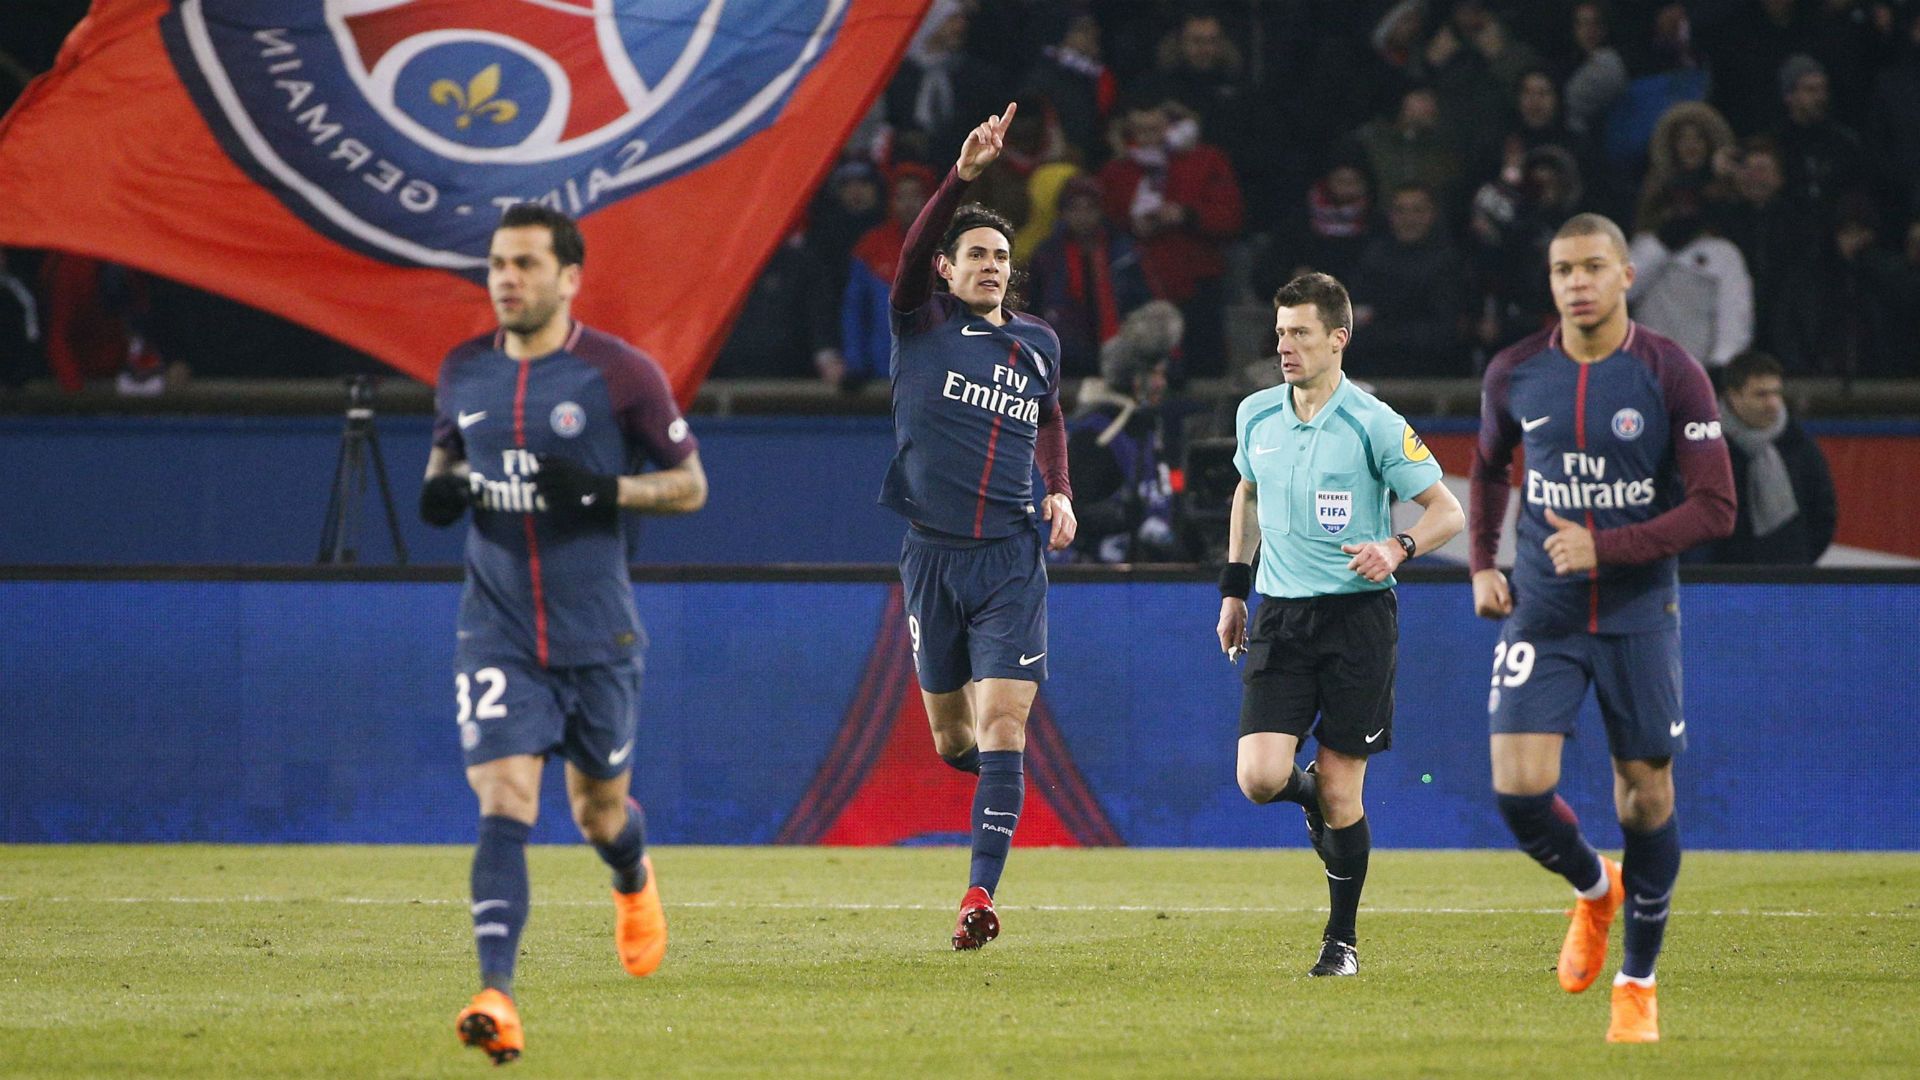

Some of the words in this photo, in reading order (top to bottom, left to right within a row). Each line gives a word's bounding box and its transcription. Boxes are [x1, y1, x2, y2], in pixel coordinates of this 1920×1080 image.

[993, 364, 1028, 393] Fly
[942, 370, 1040, 424] Emirate
[1684, 421, 1722, 440] QNB
[1563, 452, 1606, 480] Fly
[1527, 469, 1656, 509] Emirates
[1320, 507, 1346, 517] FIFA
[908, 615, 920, 652] 9
[982, 823, 1013, 837] PARIS
